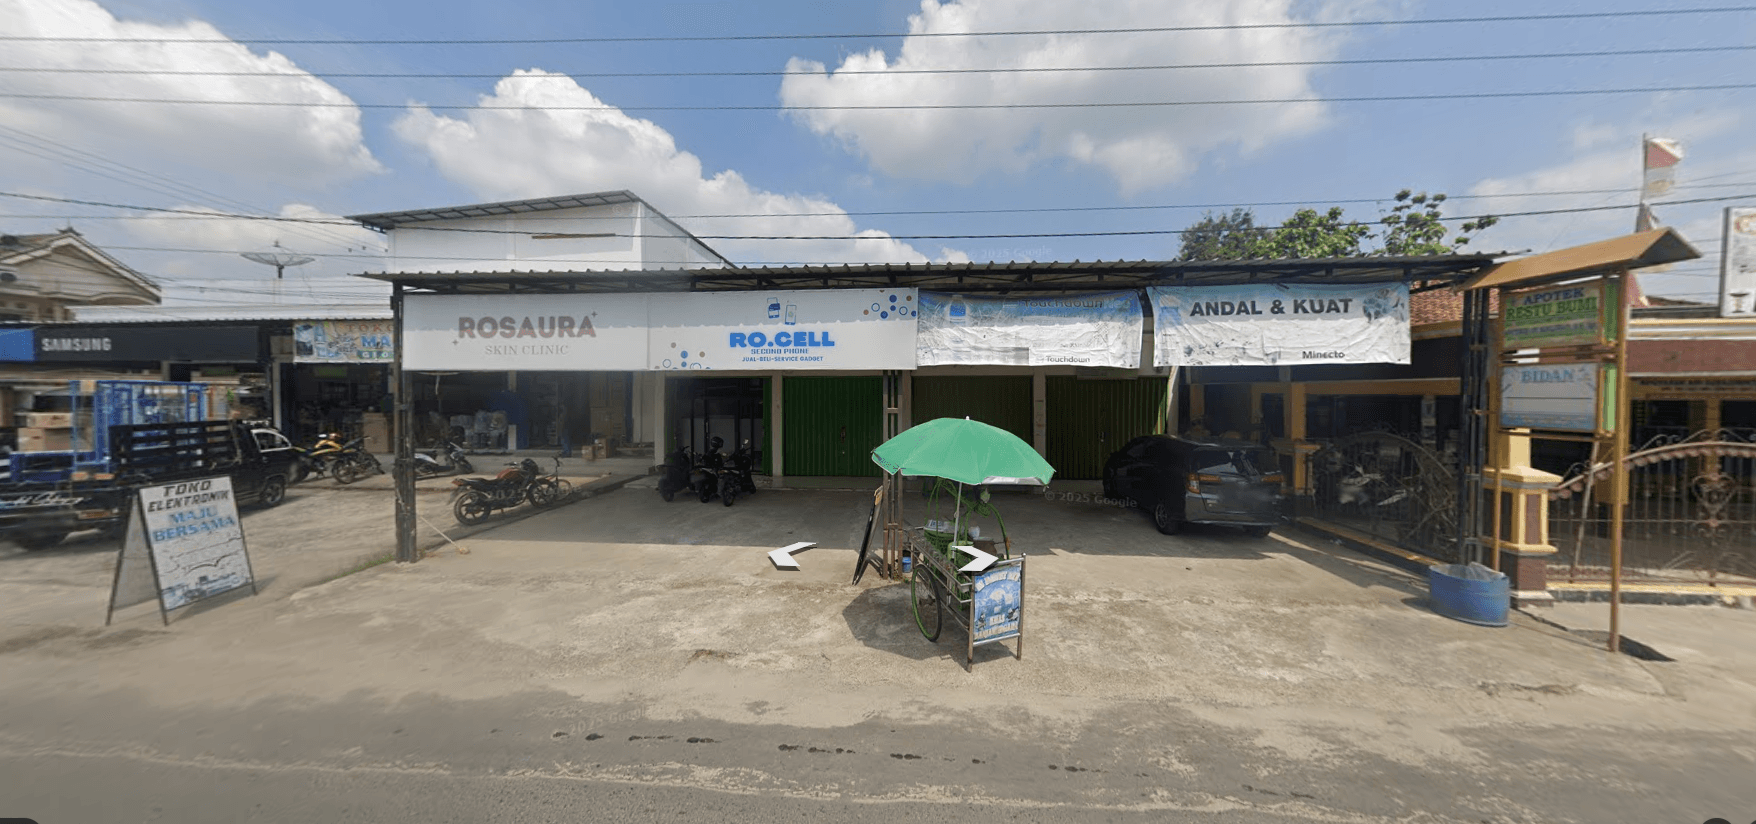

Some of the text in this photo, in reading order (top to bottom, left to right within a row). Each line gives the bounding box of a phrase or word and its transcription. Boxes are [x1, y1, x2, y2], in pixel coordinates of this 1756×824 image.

[1023, 298, 1103, 309] Touchdown
[1524, 288, 1584, 305] APOTEK
[1190, 298, 1353, 316] ANDAL & KUAT
[1506, 301, 1552, 320] RESTU
[458, 316, 597, 339] ROSAURA
[41, 337, 112, 352] SAMSUNG
[729, 331, 835, 348] RO.CELL
[484, 344, 570, 356] SKIN CLINIC
[1302, 351, 1345, 360] Minecto
[1520, 369, 1574, 384] BIDAN
[163, 480, 211, 497] TOKO
[147, 489, 229, 513] ELEKTRONIK
[169, 505, 218, 524] MAJU
[154, 516, 235, 541] BERSAMA
